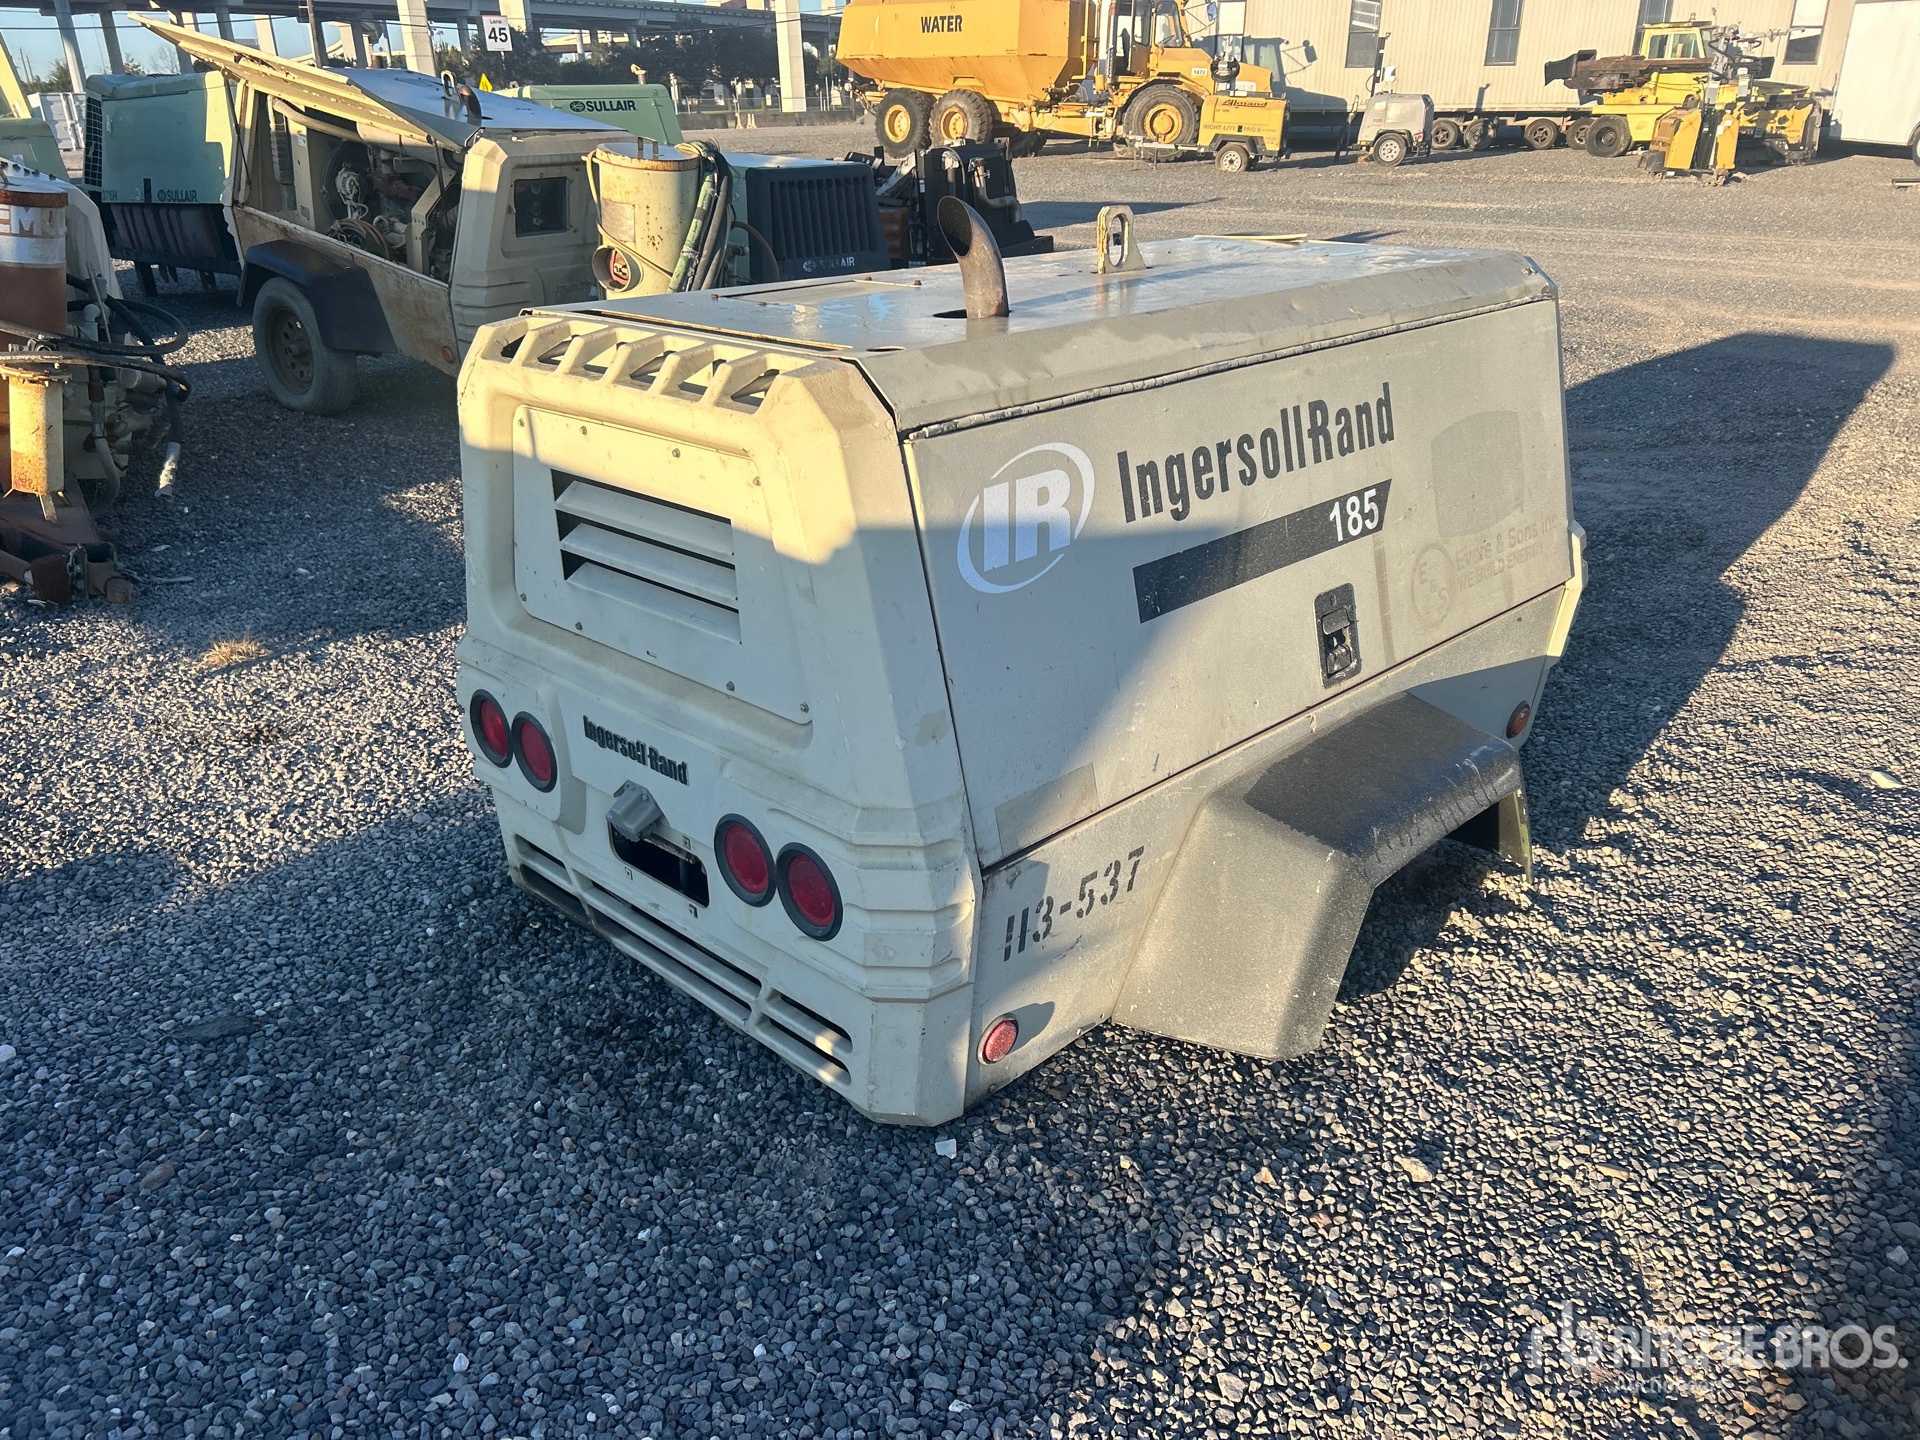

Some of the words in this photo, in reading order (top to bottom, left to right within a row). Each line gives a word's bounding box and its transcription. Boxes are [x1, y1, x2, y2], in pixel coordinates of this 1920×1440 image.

[921, 15, 963, 33] WATER
[488, 27, 508, 43] 45
[586, 100, 637, 112] SULLAIR
[166, 190, 199, 202] SULLAIR
[1329, 488, 1380, 542] 185
[1508, 522, 1538, 548] Sons
[1004, 846, 1145, 962] 113-537
